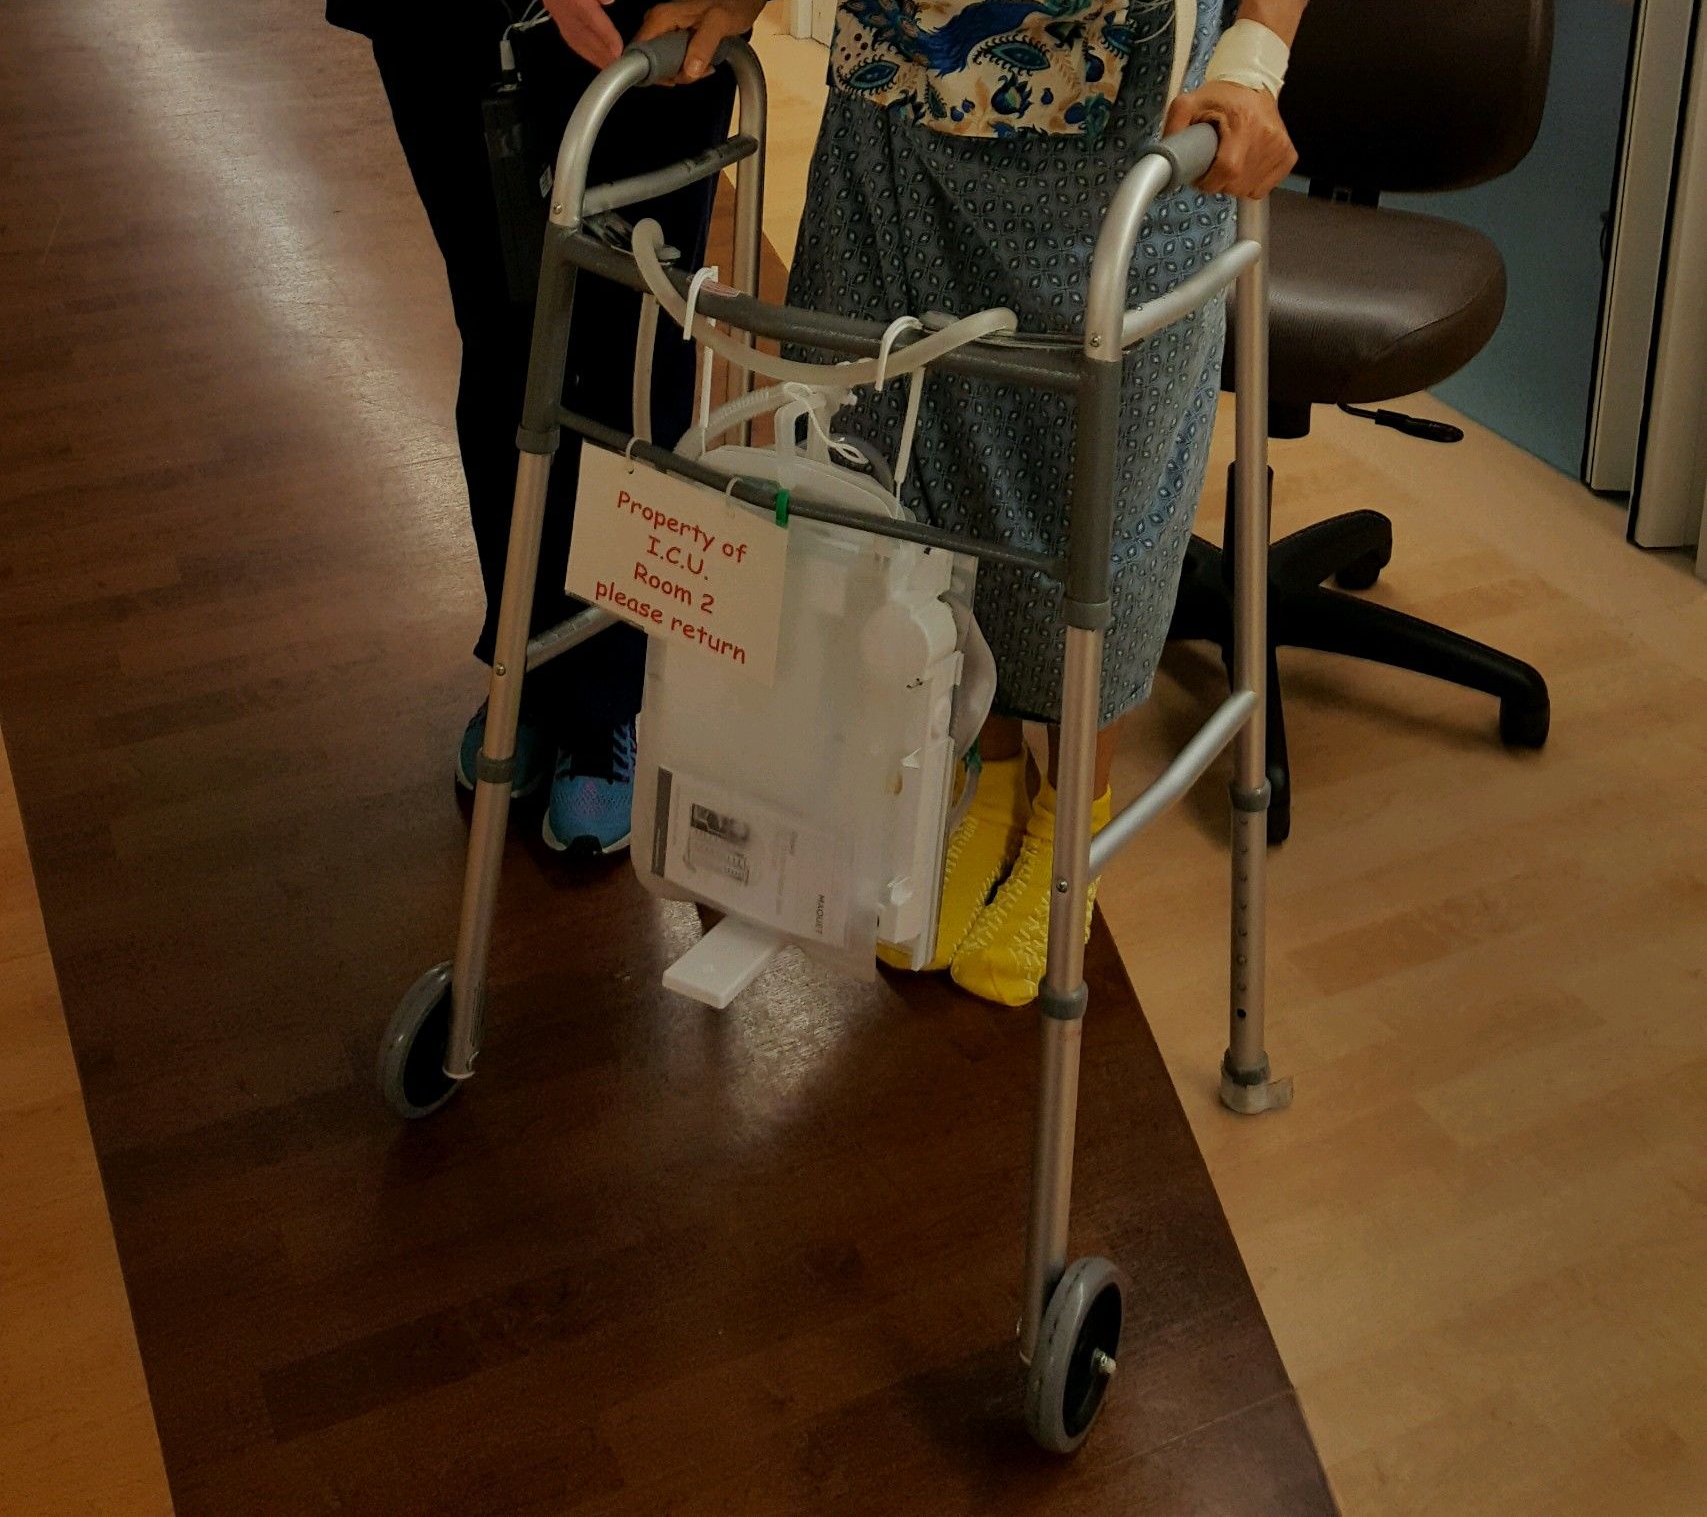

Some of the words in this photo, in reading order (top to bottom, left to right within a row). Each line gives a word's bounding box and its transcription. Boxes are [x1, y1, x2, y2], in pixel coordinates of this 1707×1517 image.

[617, 490, 715, 552] Property
[722, 542, 747, 563] of
[634, 562, 692, 605] Room
[700, 594, 714, 614] 2
[647, 535, 708, 581] I.C.U.
[595, 581, 663, 624] please
[671, 616, 746, 664] return
